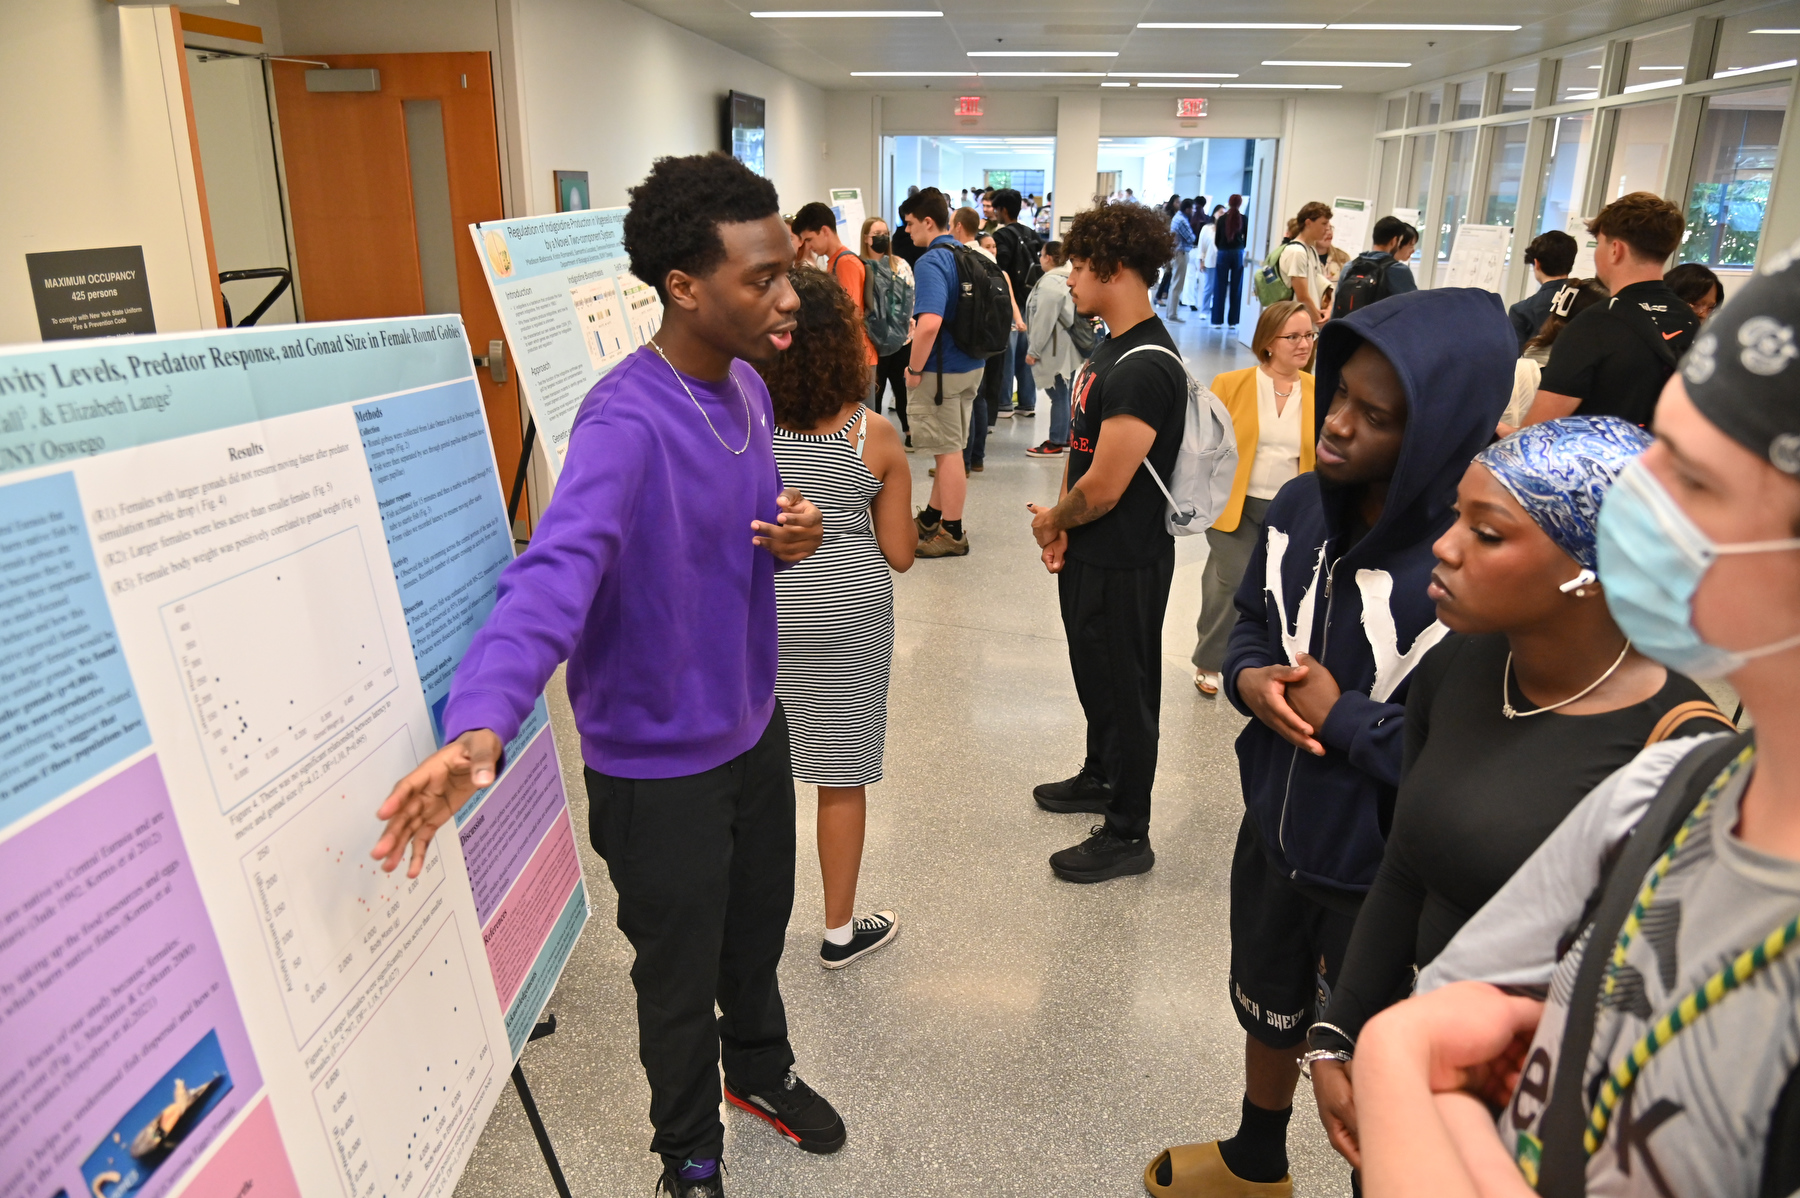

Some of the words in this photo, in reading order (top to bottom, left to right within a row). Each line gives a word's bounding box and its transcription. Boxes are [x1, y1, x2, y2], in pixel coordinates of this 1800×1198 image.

[507, 223, 538, 240] Regulation
[538, 222, 544, 234] of
[544, 239, 553, 252] by
[555, 235, 570, 248] Novel
[44, 276, 86, 288] MAXIMUM
[88, 270, 136, 284] OCCUPANCY
[72, 291, 85, 301] 425
[88, 288, 118, 301] persons
[505, 287, 532, 300] Introduction
[59, 316, 77, 324] comply
[89, 319, 113, 328] Prevention
[49, 358, 129, 388] Levels,
[128, 352, 206, 379] Predator
[208, 346, 281, 370] Response,
[283, 339, 305, 359] and
[306, 335, 344, 357] Gonad
[344, 333, 366, 352] Size
[367, 332, 379, 348] in
[380, 328, 411, 347] Female
[412, 326, 436, 343] Round
[437, 324, 460, 340] Gobies
[531, 361, 551, 377] Approach
[57, 395, 128, 424] Elizabeth
[355, 407, 383, 424] Methods
[360, 426, 380, 437] Collection
[552, 430, 569, 443] Genetic
[39, 435, 105, 461] Oswego
[228, 443, 264, 461] Results
[119, 498, 155, 516] Females
[157, 491, 175, 504] with
[176, 485, 200, 499] larger
[202, 476, 227, 495] gonads
[229, 472, 240, 485] did
[241, 471, 252, 480] not
[278, 458, 298, 471] moving
[299, 454, 314, 464] faster
[316, 449, 328, 459] after
[329, 444, 349, 458] predator
[129, 541, 159, 559] Larger
[160, 530, 192, 548] females
[213, 517, 227, 529] less
[229, 511, 249, 525] active
[251, 507, 266, 518] than
[137, 565, 170, 586] Female
[170, 557, 191, 573] body
[394, 557, 408, 568] Activity
[404, 600, 423, 615] Dissection
[460, 814, 486, 847] Discussion
[483, 909, 508, 946] References
[506, 971, 538, 1029] Acknowledgements
[1266, 1008, 1304, 1032] SHEEP
